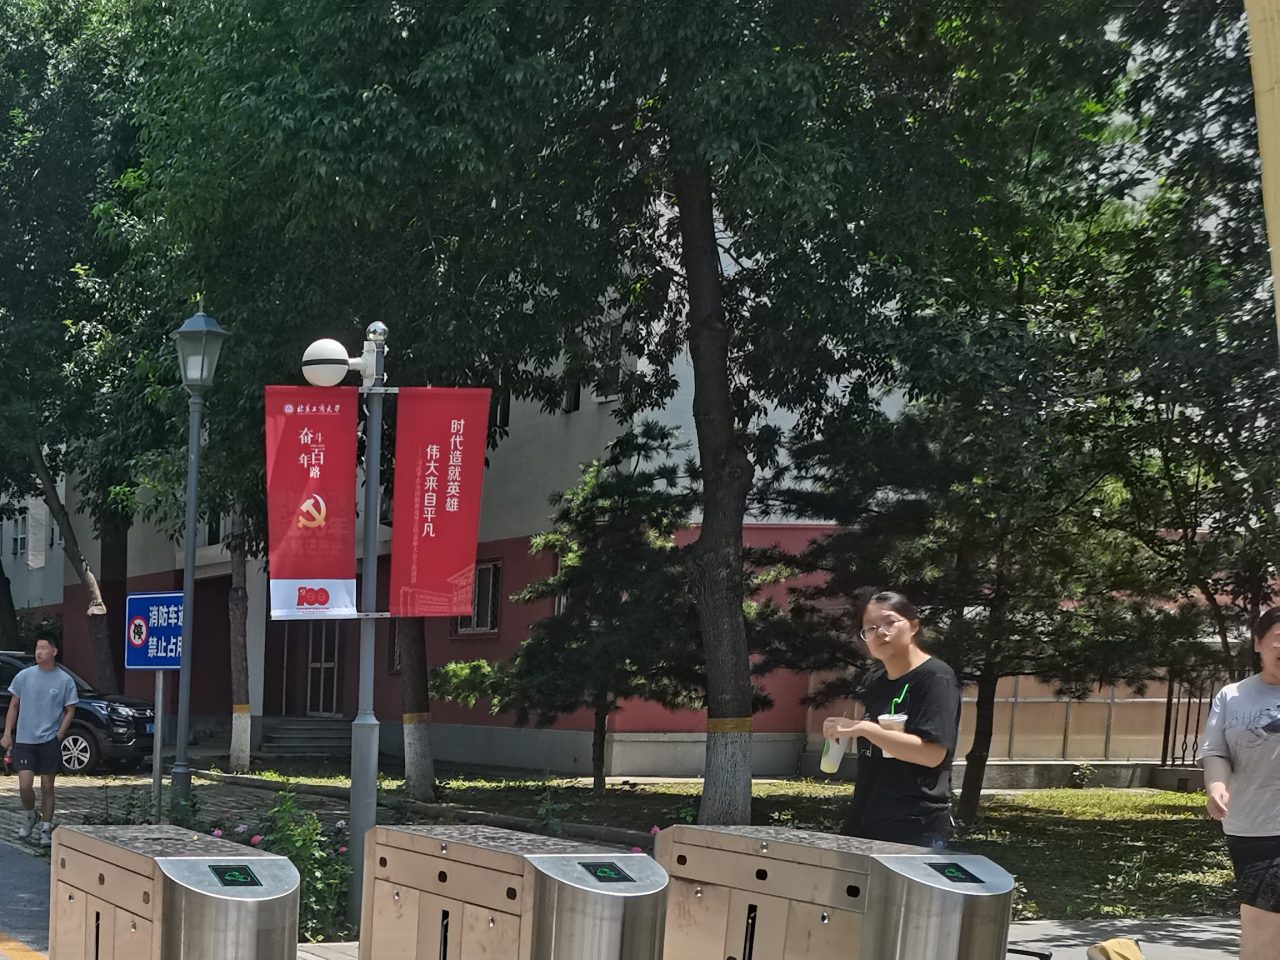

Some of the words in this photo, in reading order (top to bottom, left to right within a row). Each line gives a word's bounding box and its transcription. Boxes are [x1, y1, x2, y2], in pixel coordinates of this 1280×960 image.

[422, 444, 440, 538] 伟大来自平凡
[445, 418, 465, 512] 时代造就英雄
